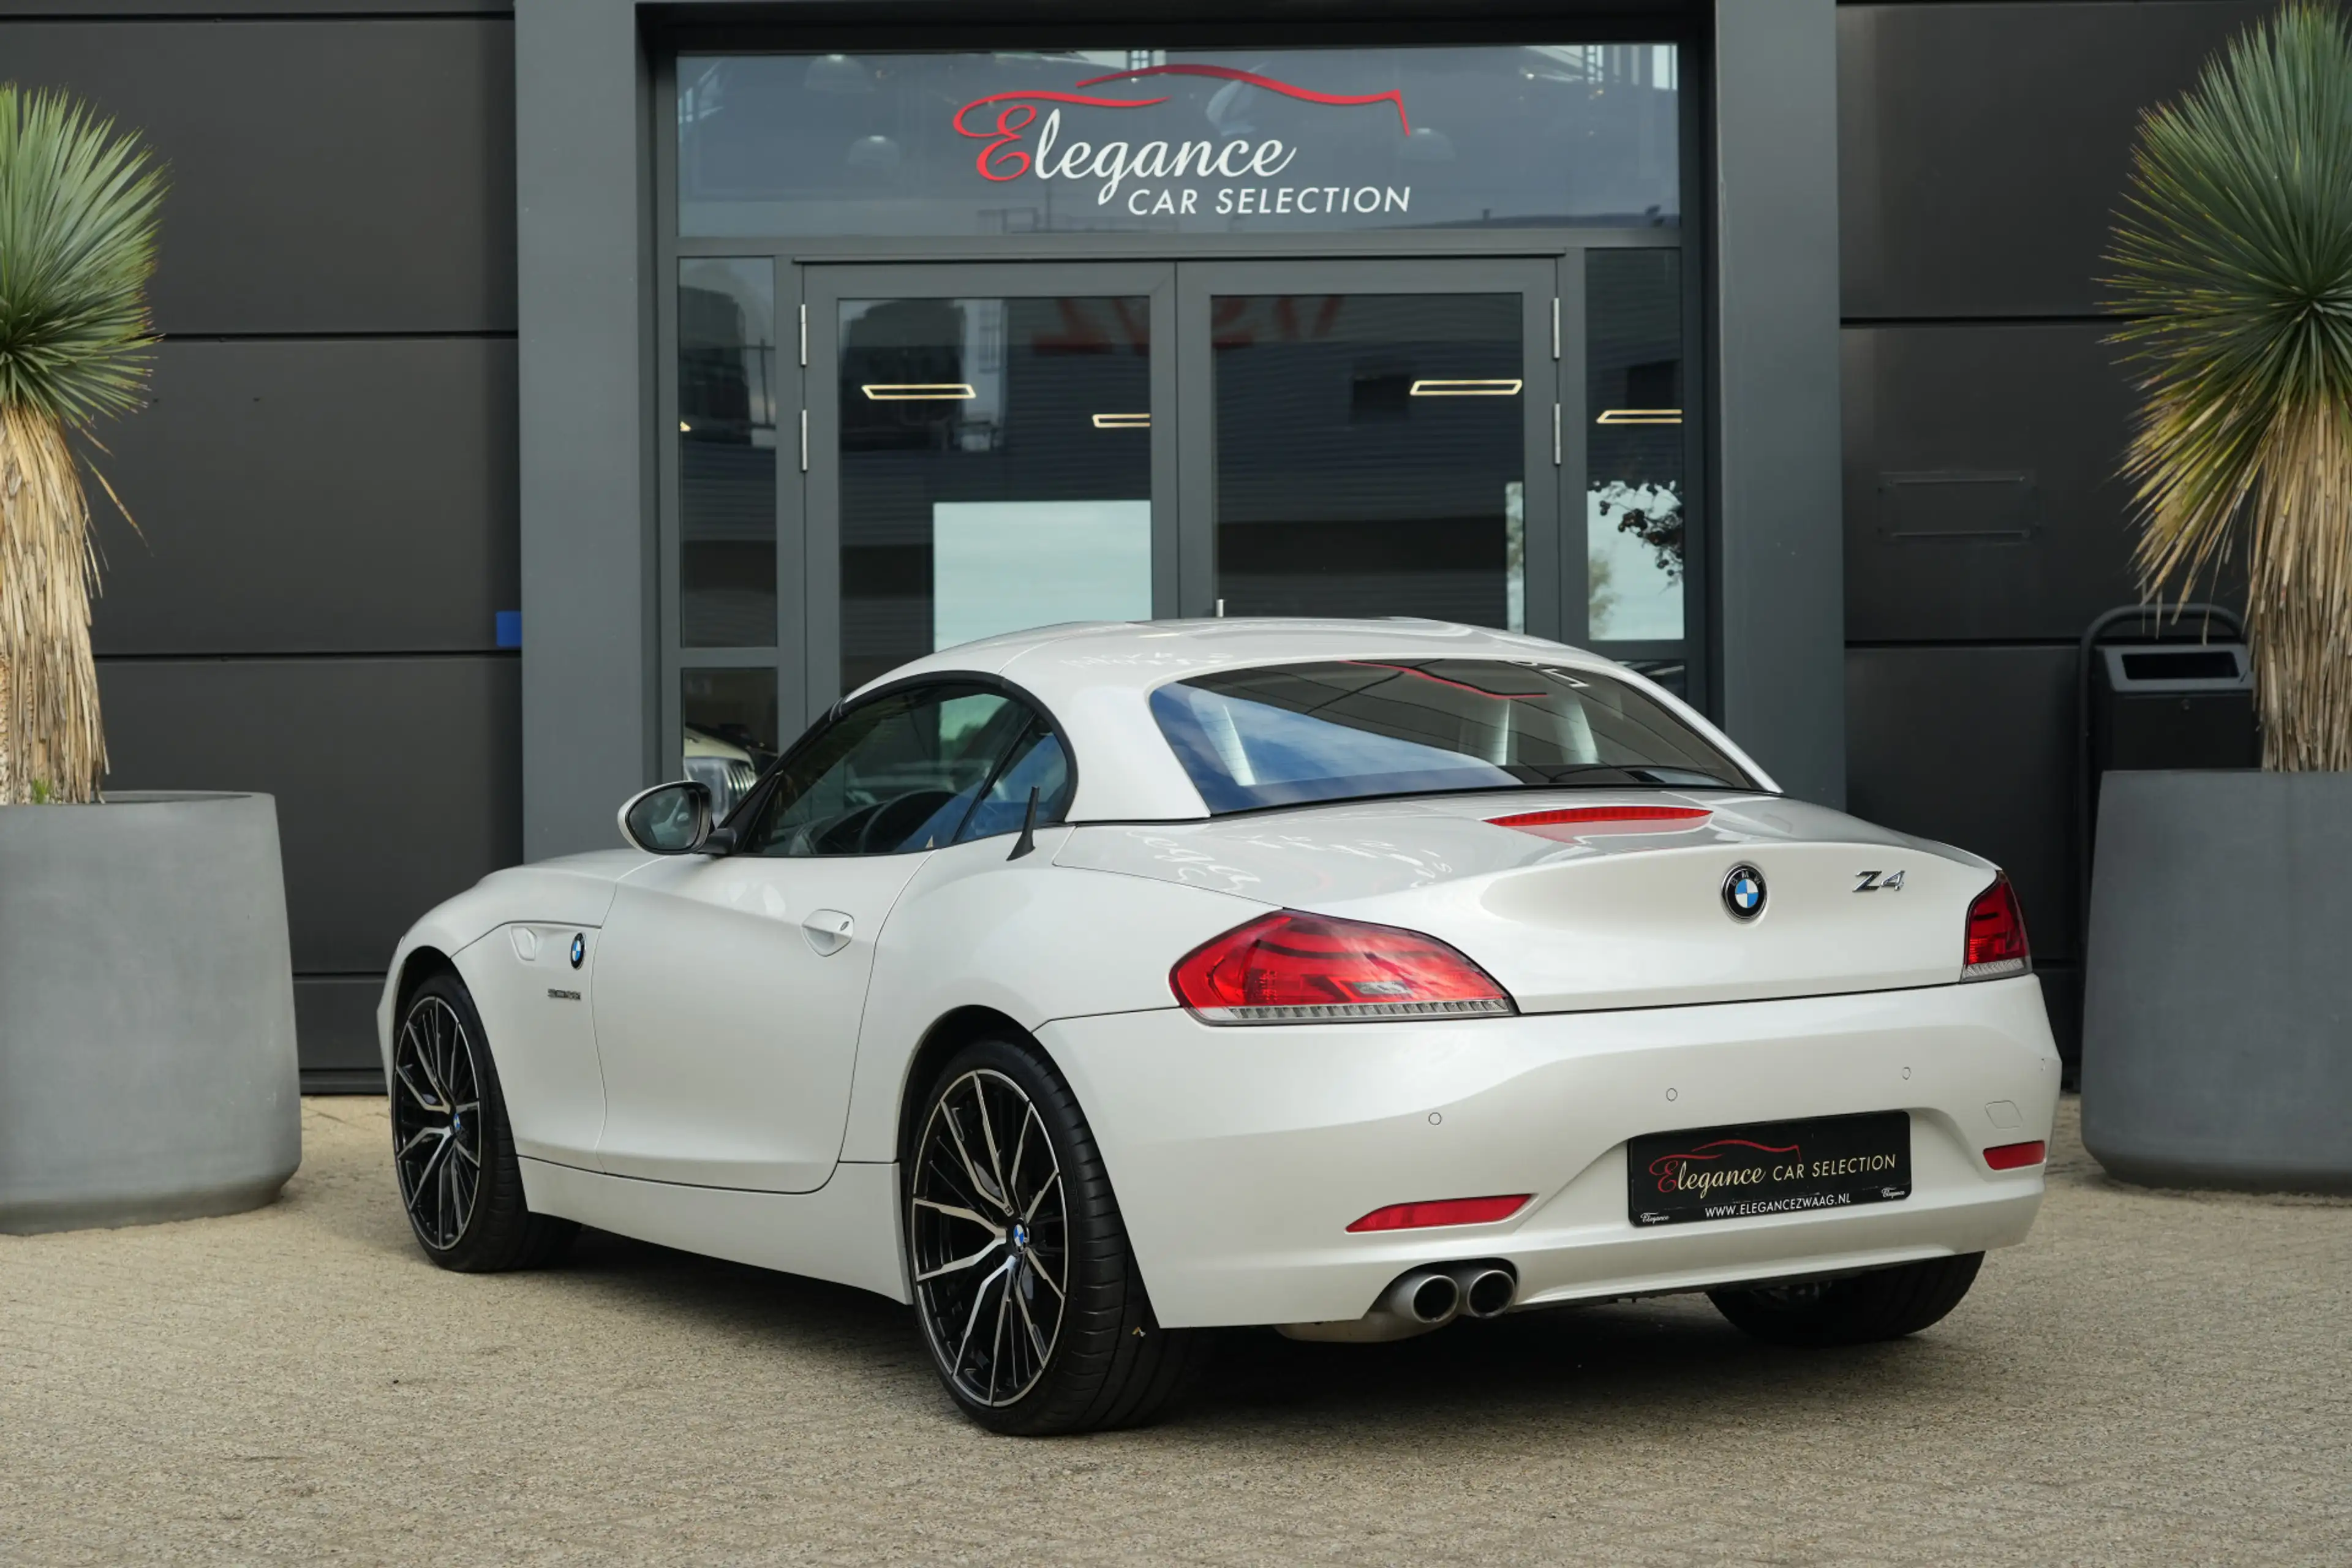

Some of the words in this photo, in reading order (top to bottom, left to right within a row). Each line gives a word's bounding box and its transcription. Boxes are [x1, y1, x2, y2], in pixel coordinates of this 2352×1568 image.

[954, 93, 1297, 206] Elegance
[1128, 189, 1198, 215] CAR
[1215, 186, 1411, 214] SELECTION
[1852, 870, 1906, 893] Z4
[1649, 1158, 1766, 1199] Elegance
[1773, 1163, 1804, 1182] CAR
[1811, 1153, 1897, 1178] SELECTION
[1705, 1192, 1851, 1218] WWW.ELEGANCEZWAAG.NL
[1640, 1213, 1670, 1225] Elegance
